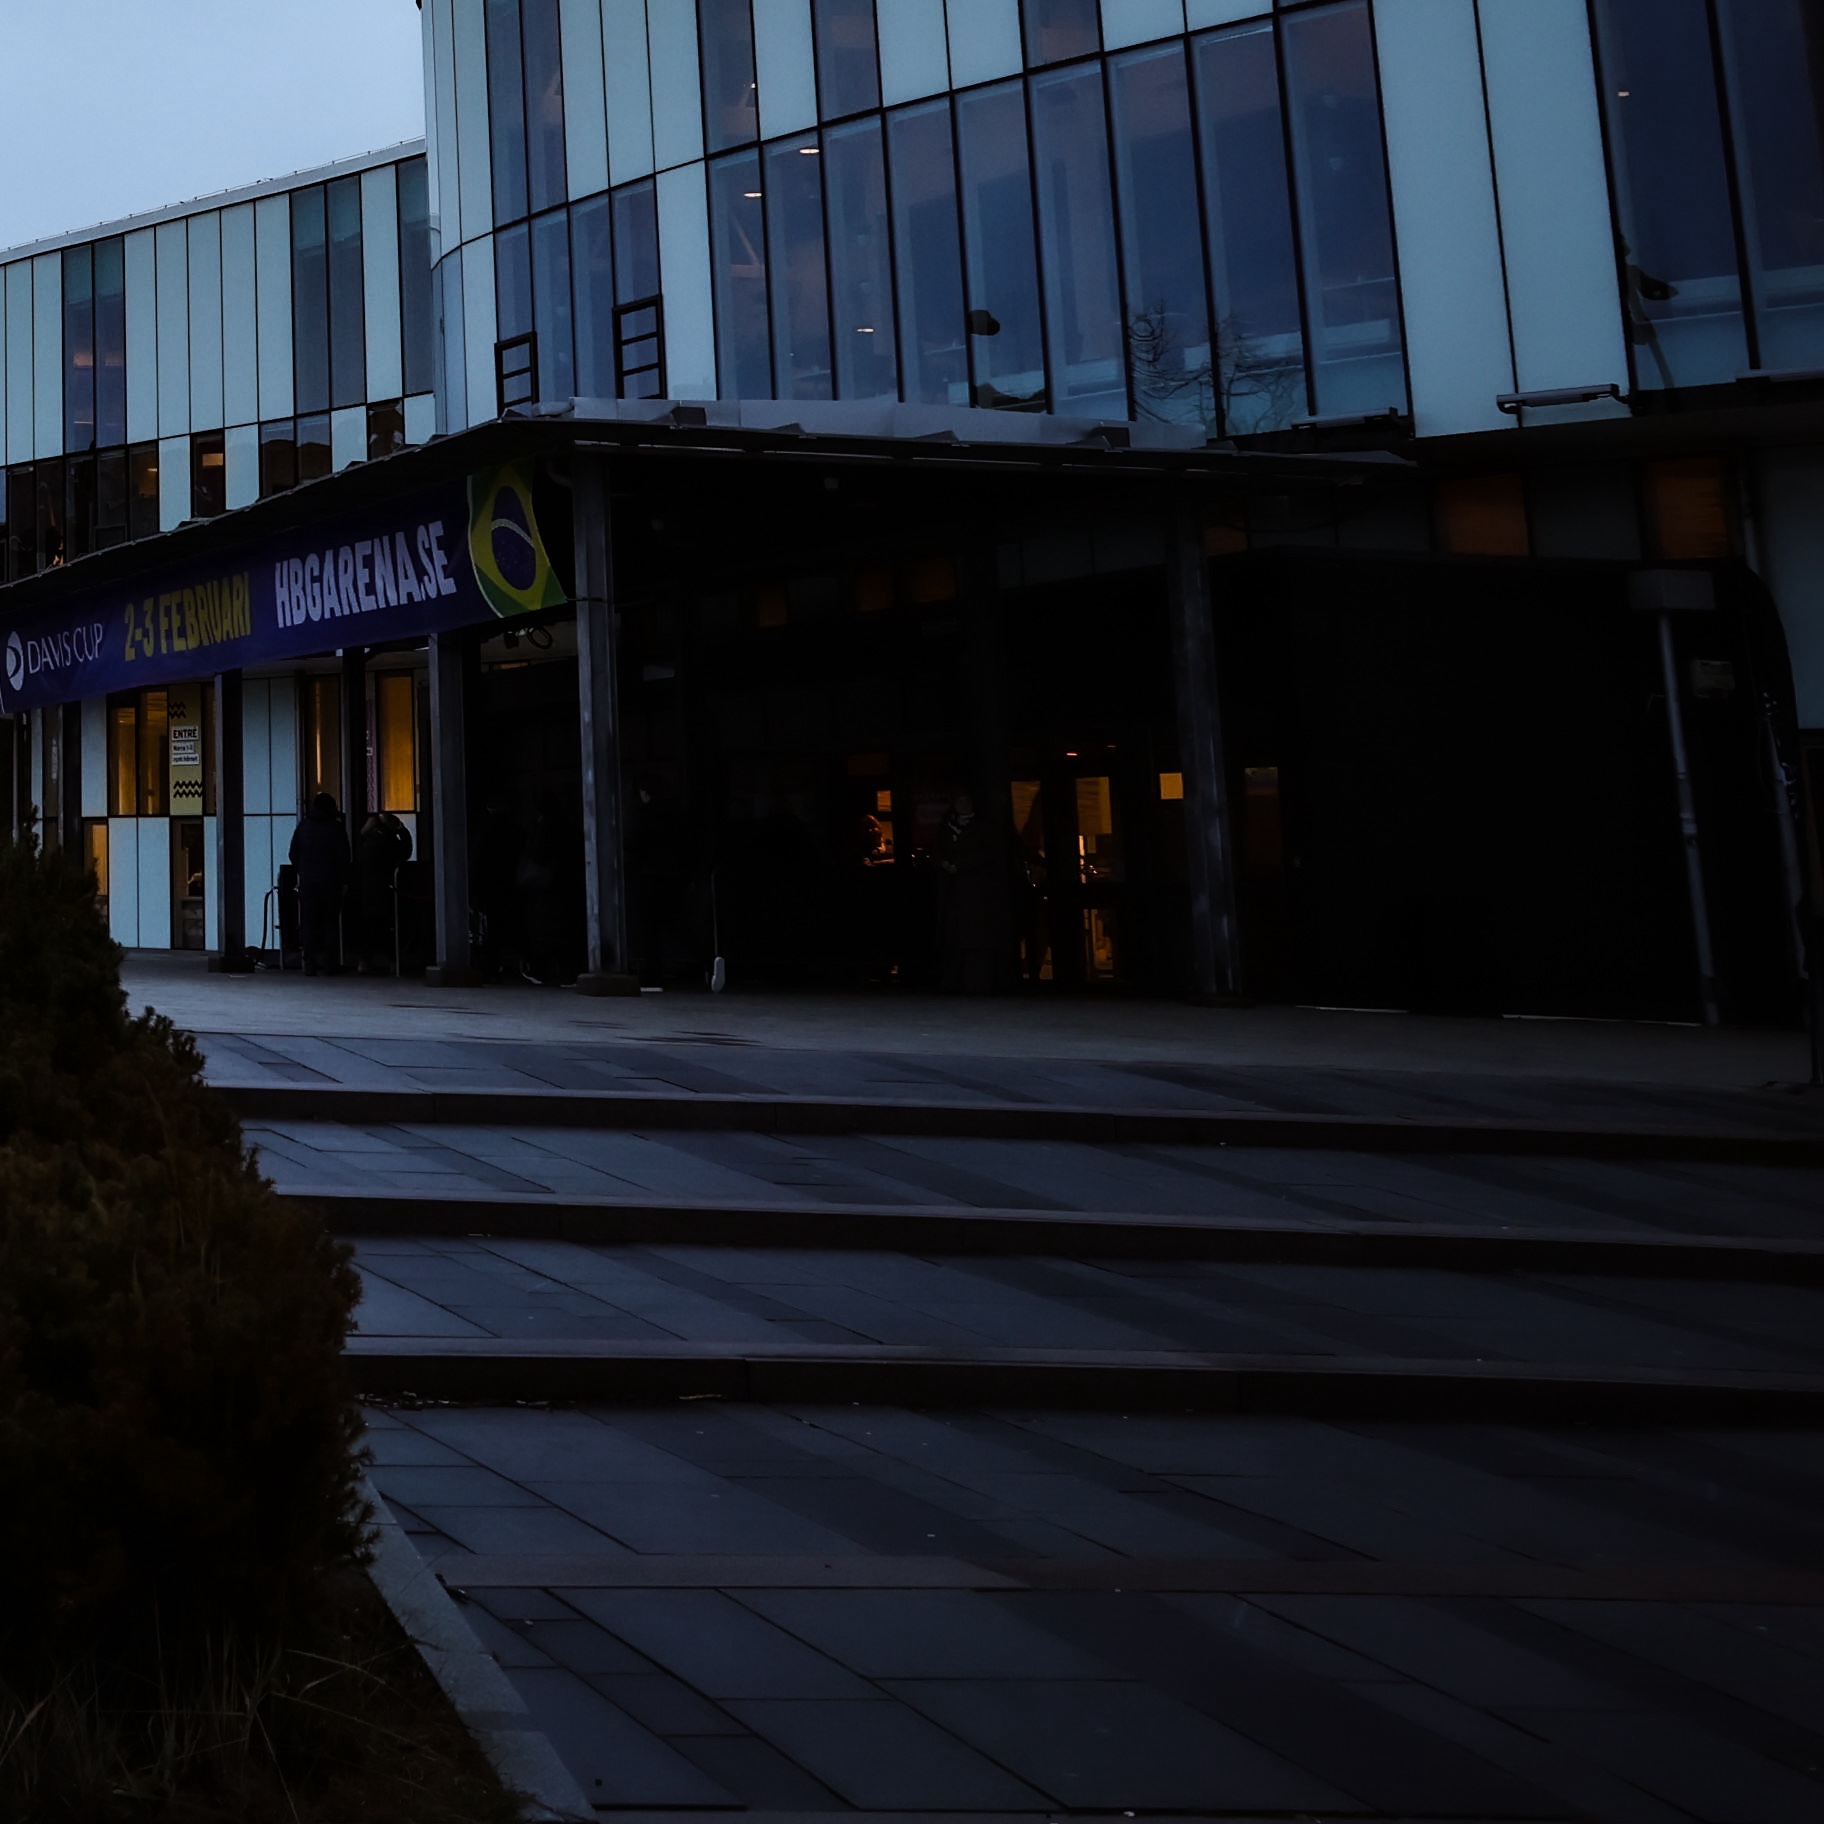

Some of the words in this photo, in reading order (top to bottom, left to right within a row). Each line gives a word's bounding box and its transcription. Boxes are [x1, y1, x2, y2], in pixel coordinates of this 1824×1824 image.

[27, 631, 72, 675] DAVIS
[73, 622, 104, 663] CUP
[124, 595, 155, 662] 2-3
[159, 571, 252, 655] FEBRUARI
[275, 519, 458, 629] HBGARENA.SE
